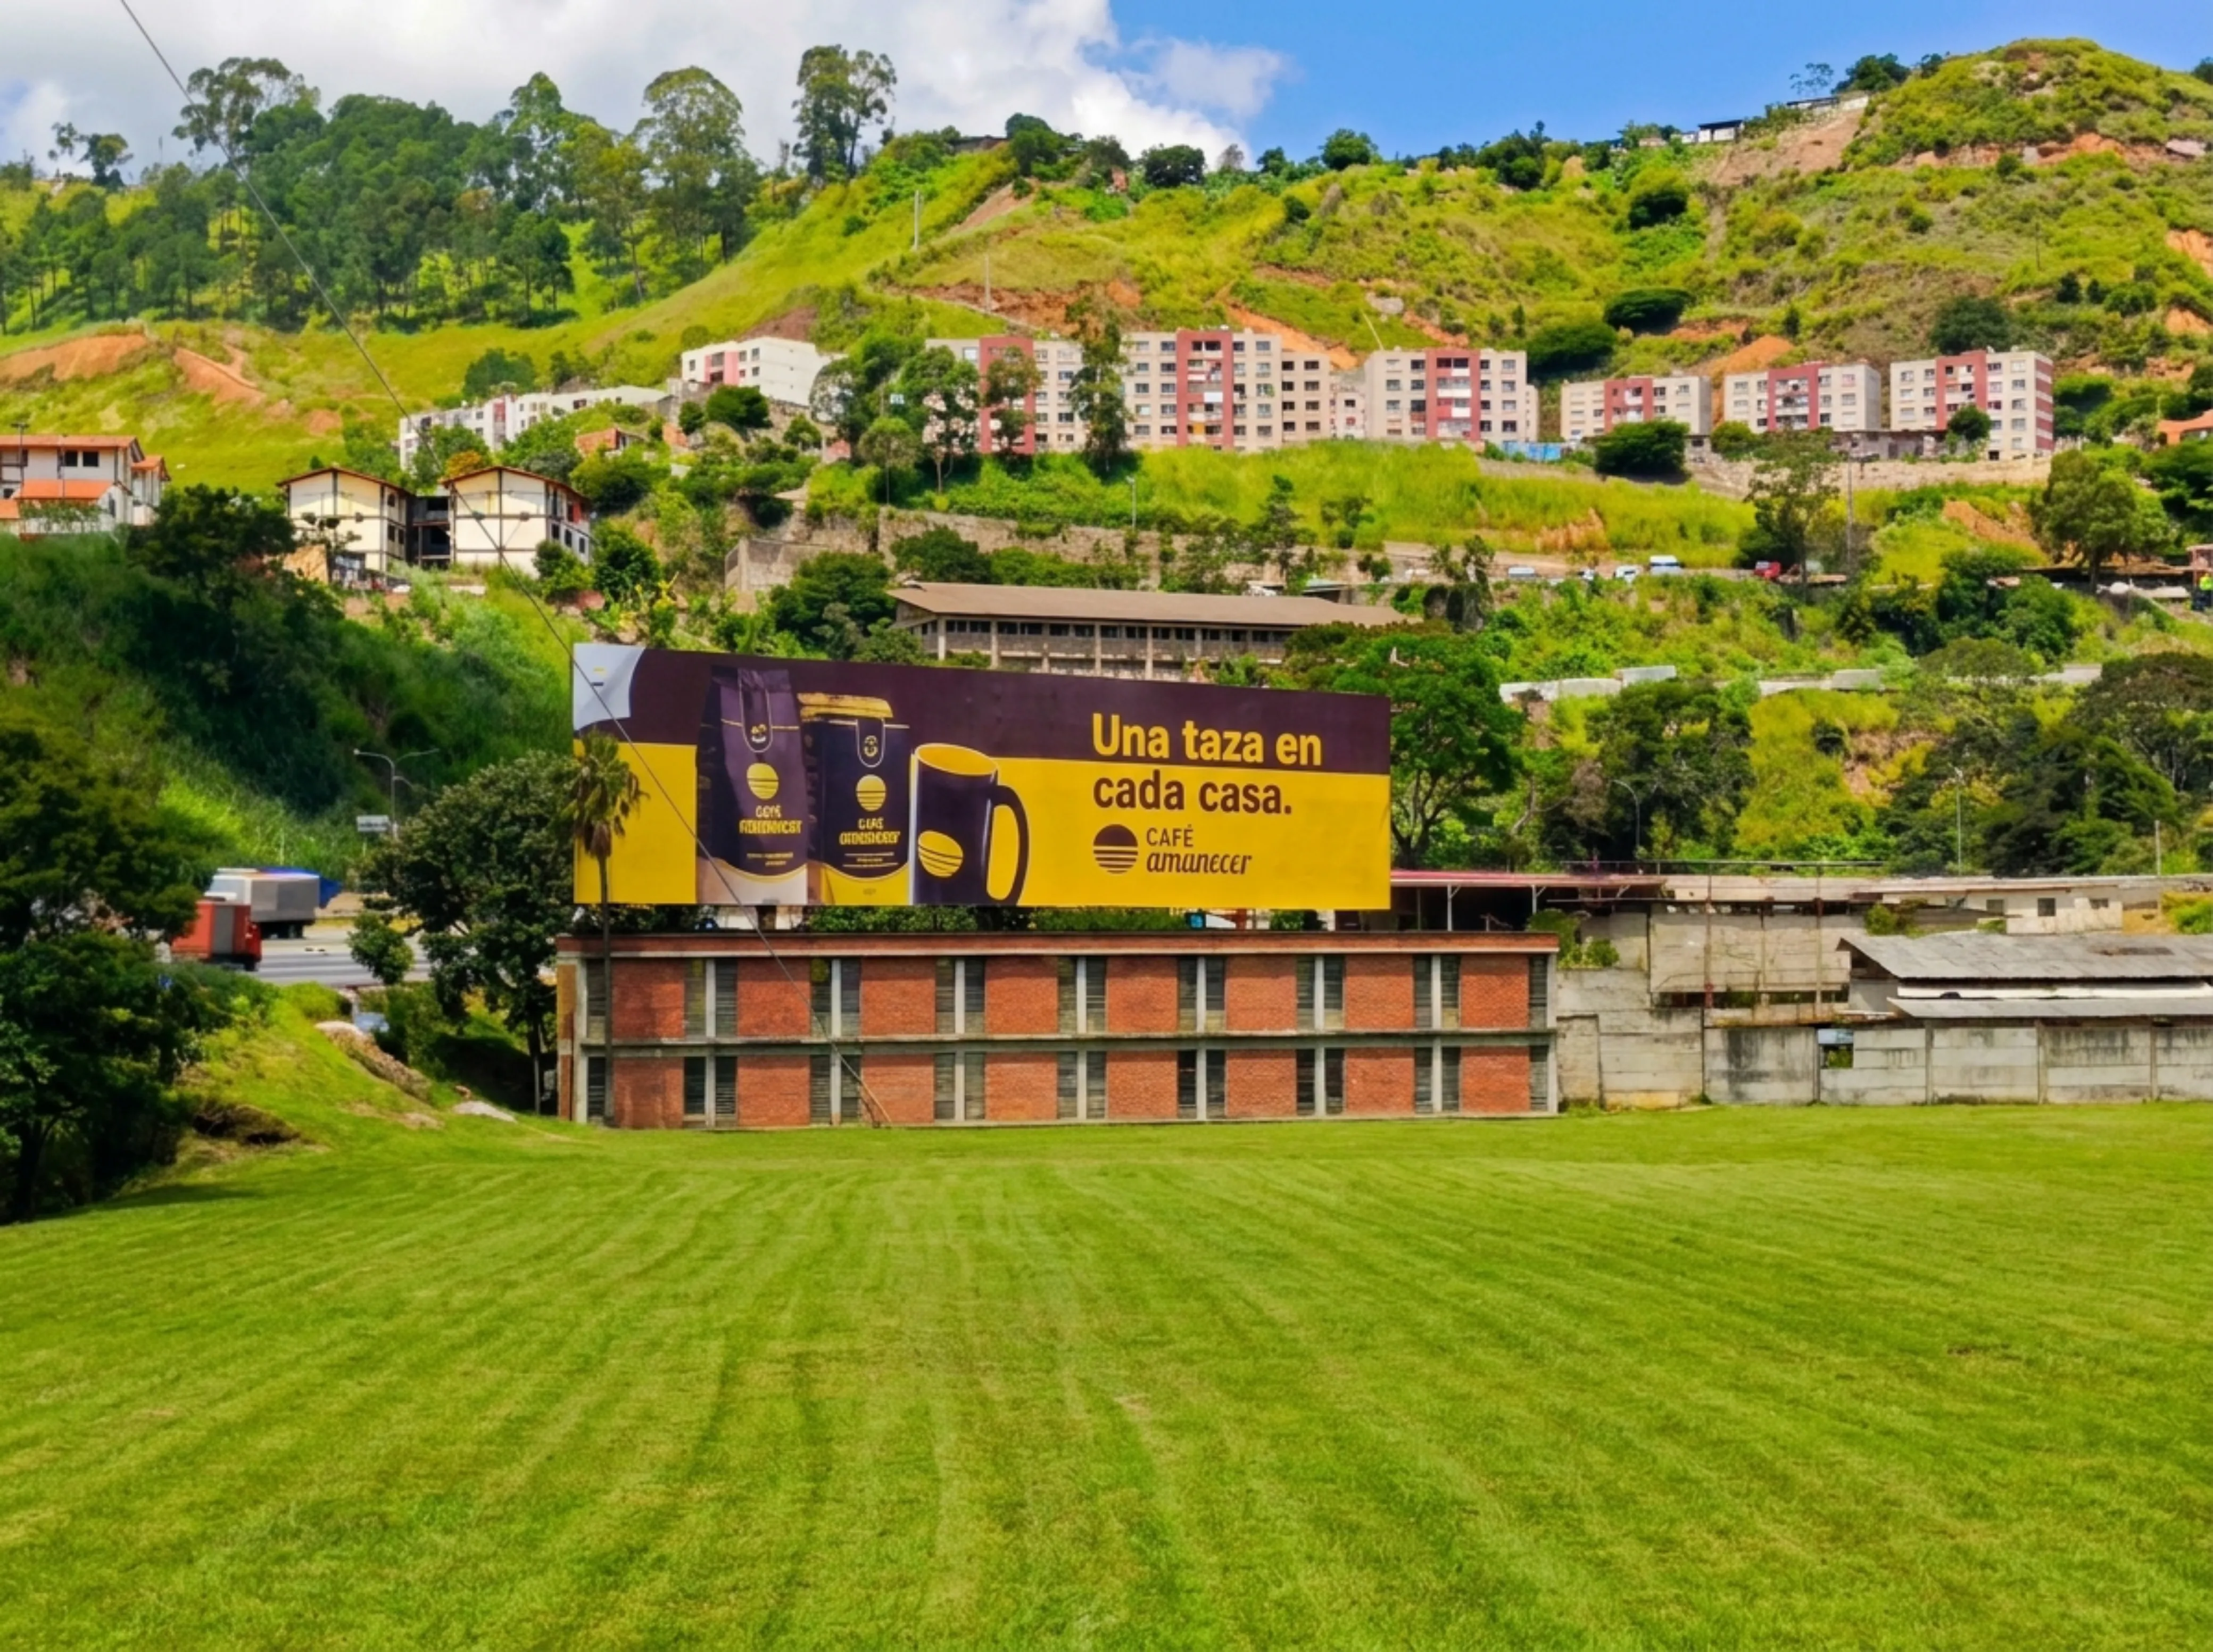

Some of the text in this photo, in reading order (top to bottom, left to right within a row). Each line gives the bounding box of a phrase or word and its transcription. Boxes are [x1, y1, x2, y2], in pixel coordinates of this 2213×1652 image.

[1092, 712, 1322, 766] Una taza en
[1093, 768, 1292, 815] cada casa.
[1146, 825, 1194, 848] CAFÉ
[1146, 851, 1253, 875] amanecer
